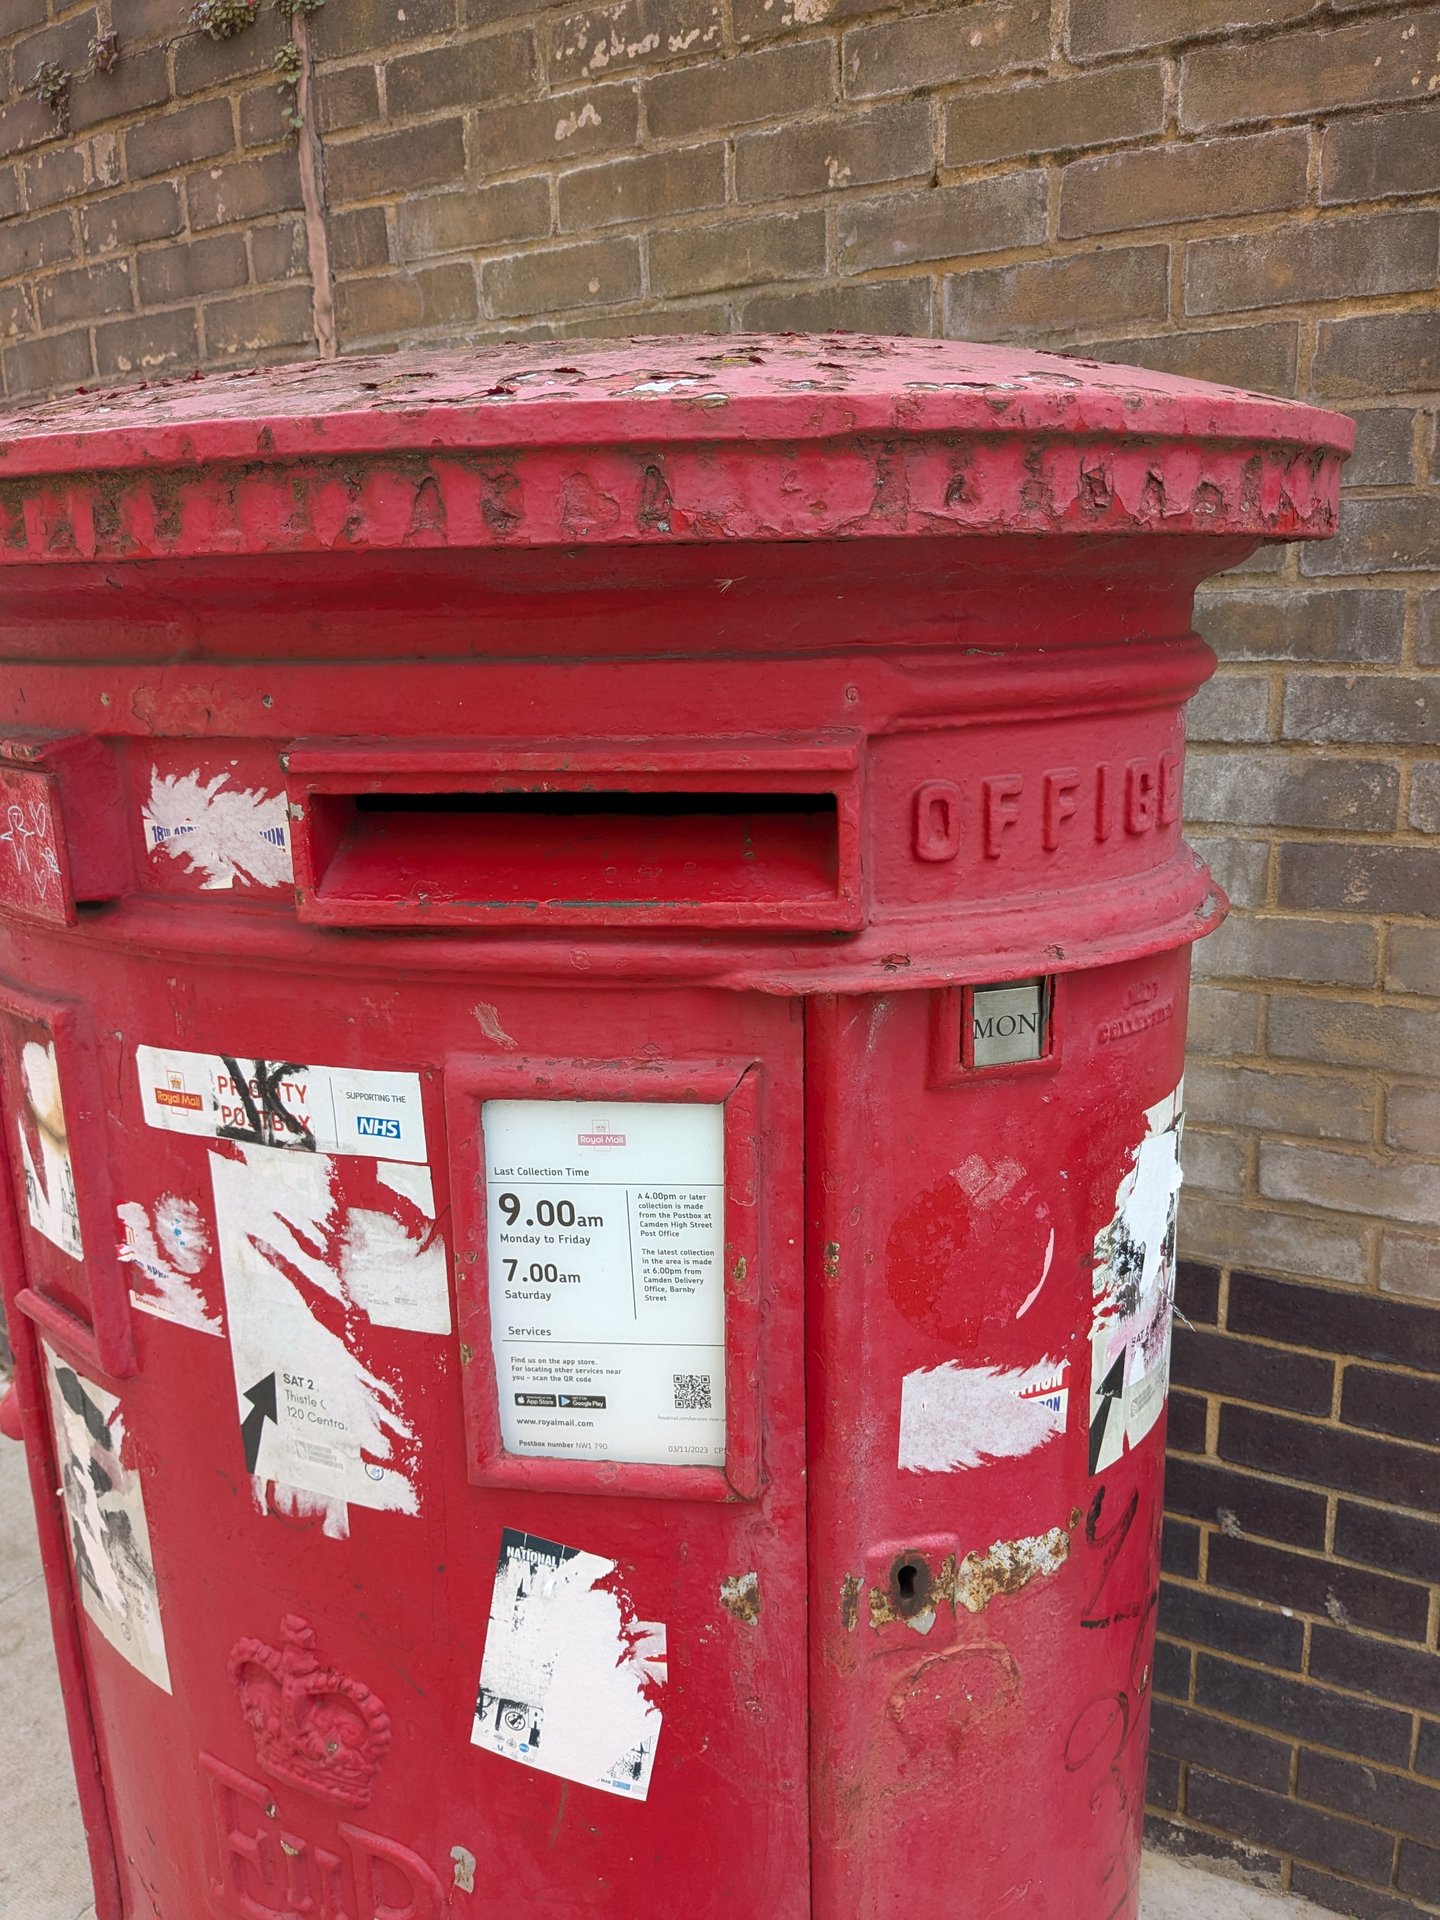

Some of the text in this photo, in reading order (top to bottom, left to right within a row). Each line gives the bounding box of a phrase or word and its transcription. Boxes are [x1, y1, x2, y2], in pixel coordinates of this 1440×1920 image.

[910, 749, 1181, 863] OFFICE
[973, 1012, 1040, 1040] MON
[157, 1090, 200, 1107] Royal Mail
[345, 1091, 407, 1104] SUPPORTING THE
[359, 1117, 398, 1137] NHS
[580, 1135, 624, 1145] Royal Mail
[494, 1166, 590, 1177] Last Collection Time
[644, 1191, 677, 1201] 4.00pm
[688, 1193, 707, 1201] later
[498, 1192, 604, 1228] 9.00am
[638, 1202, 673, 1210] collection
[675, 1202, 682, 1210] is
[638, 1211, 712, 1220] from the Postbox at
[639, 1220, 713, 1230] Camden High Street
[640, 1229, 680, 1238] Post Office
[500, 1233, 591, 1246] Monday to Friday
[641, 1248, 715, 1257] The latest collection
[641, 1257, 650, 1265] in
[651, 1257, 664, 1265] the
[683, 1258, 691, 1266] is
[692, 1258, 713, 1266] made
[502, 1258, 581, 1284] 7.00am
[642, 1266, 703, 1276] at 6.00pm from
[643, 1276, 705, 1286] Camden Delivery
[644, 1285, 696, 1295] Office, Barnby
[504, 1289, 552, 1302] Saturday
[644, 1294, 668, 1302] Street
[508, 1325, 552, 1337] Services
[510, 1356, 526, 1364] Find
[548, 1357, 561, 1365] the
[562, 1359, 576, 1367] app
[577, 1358, 598, 1366] store.
[524, 1365, 553, 1375] locating
[554, 1366, 573, 1374] other
[575, 1367, 604, 1375] services
[282, 1373, 305, 1388] SAT
[511, 1374, 525, 1382] you
[563, 1375, 574, 1383] QR
[284, 1389, 318, 1408] Thistle
[526, 1398, 539, 1406] App
[572, 1400, 592, 1408] Google
[287, 1405, 305, 1420] 120
[516, 1418, 594, 1428] www.royalmail.com
[518, 1440, 546, 1448] Postbox
[547, 1441, 574, 1449] number
[575, 1442, 592, 1450] NW1
[668, 1445, 709, 1454] 03/11/2023
[506, 1545, 558, 1568] NATIONAL
